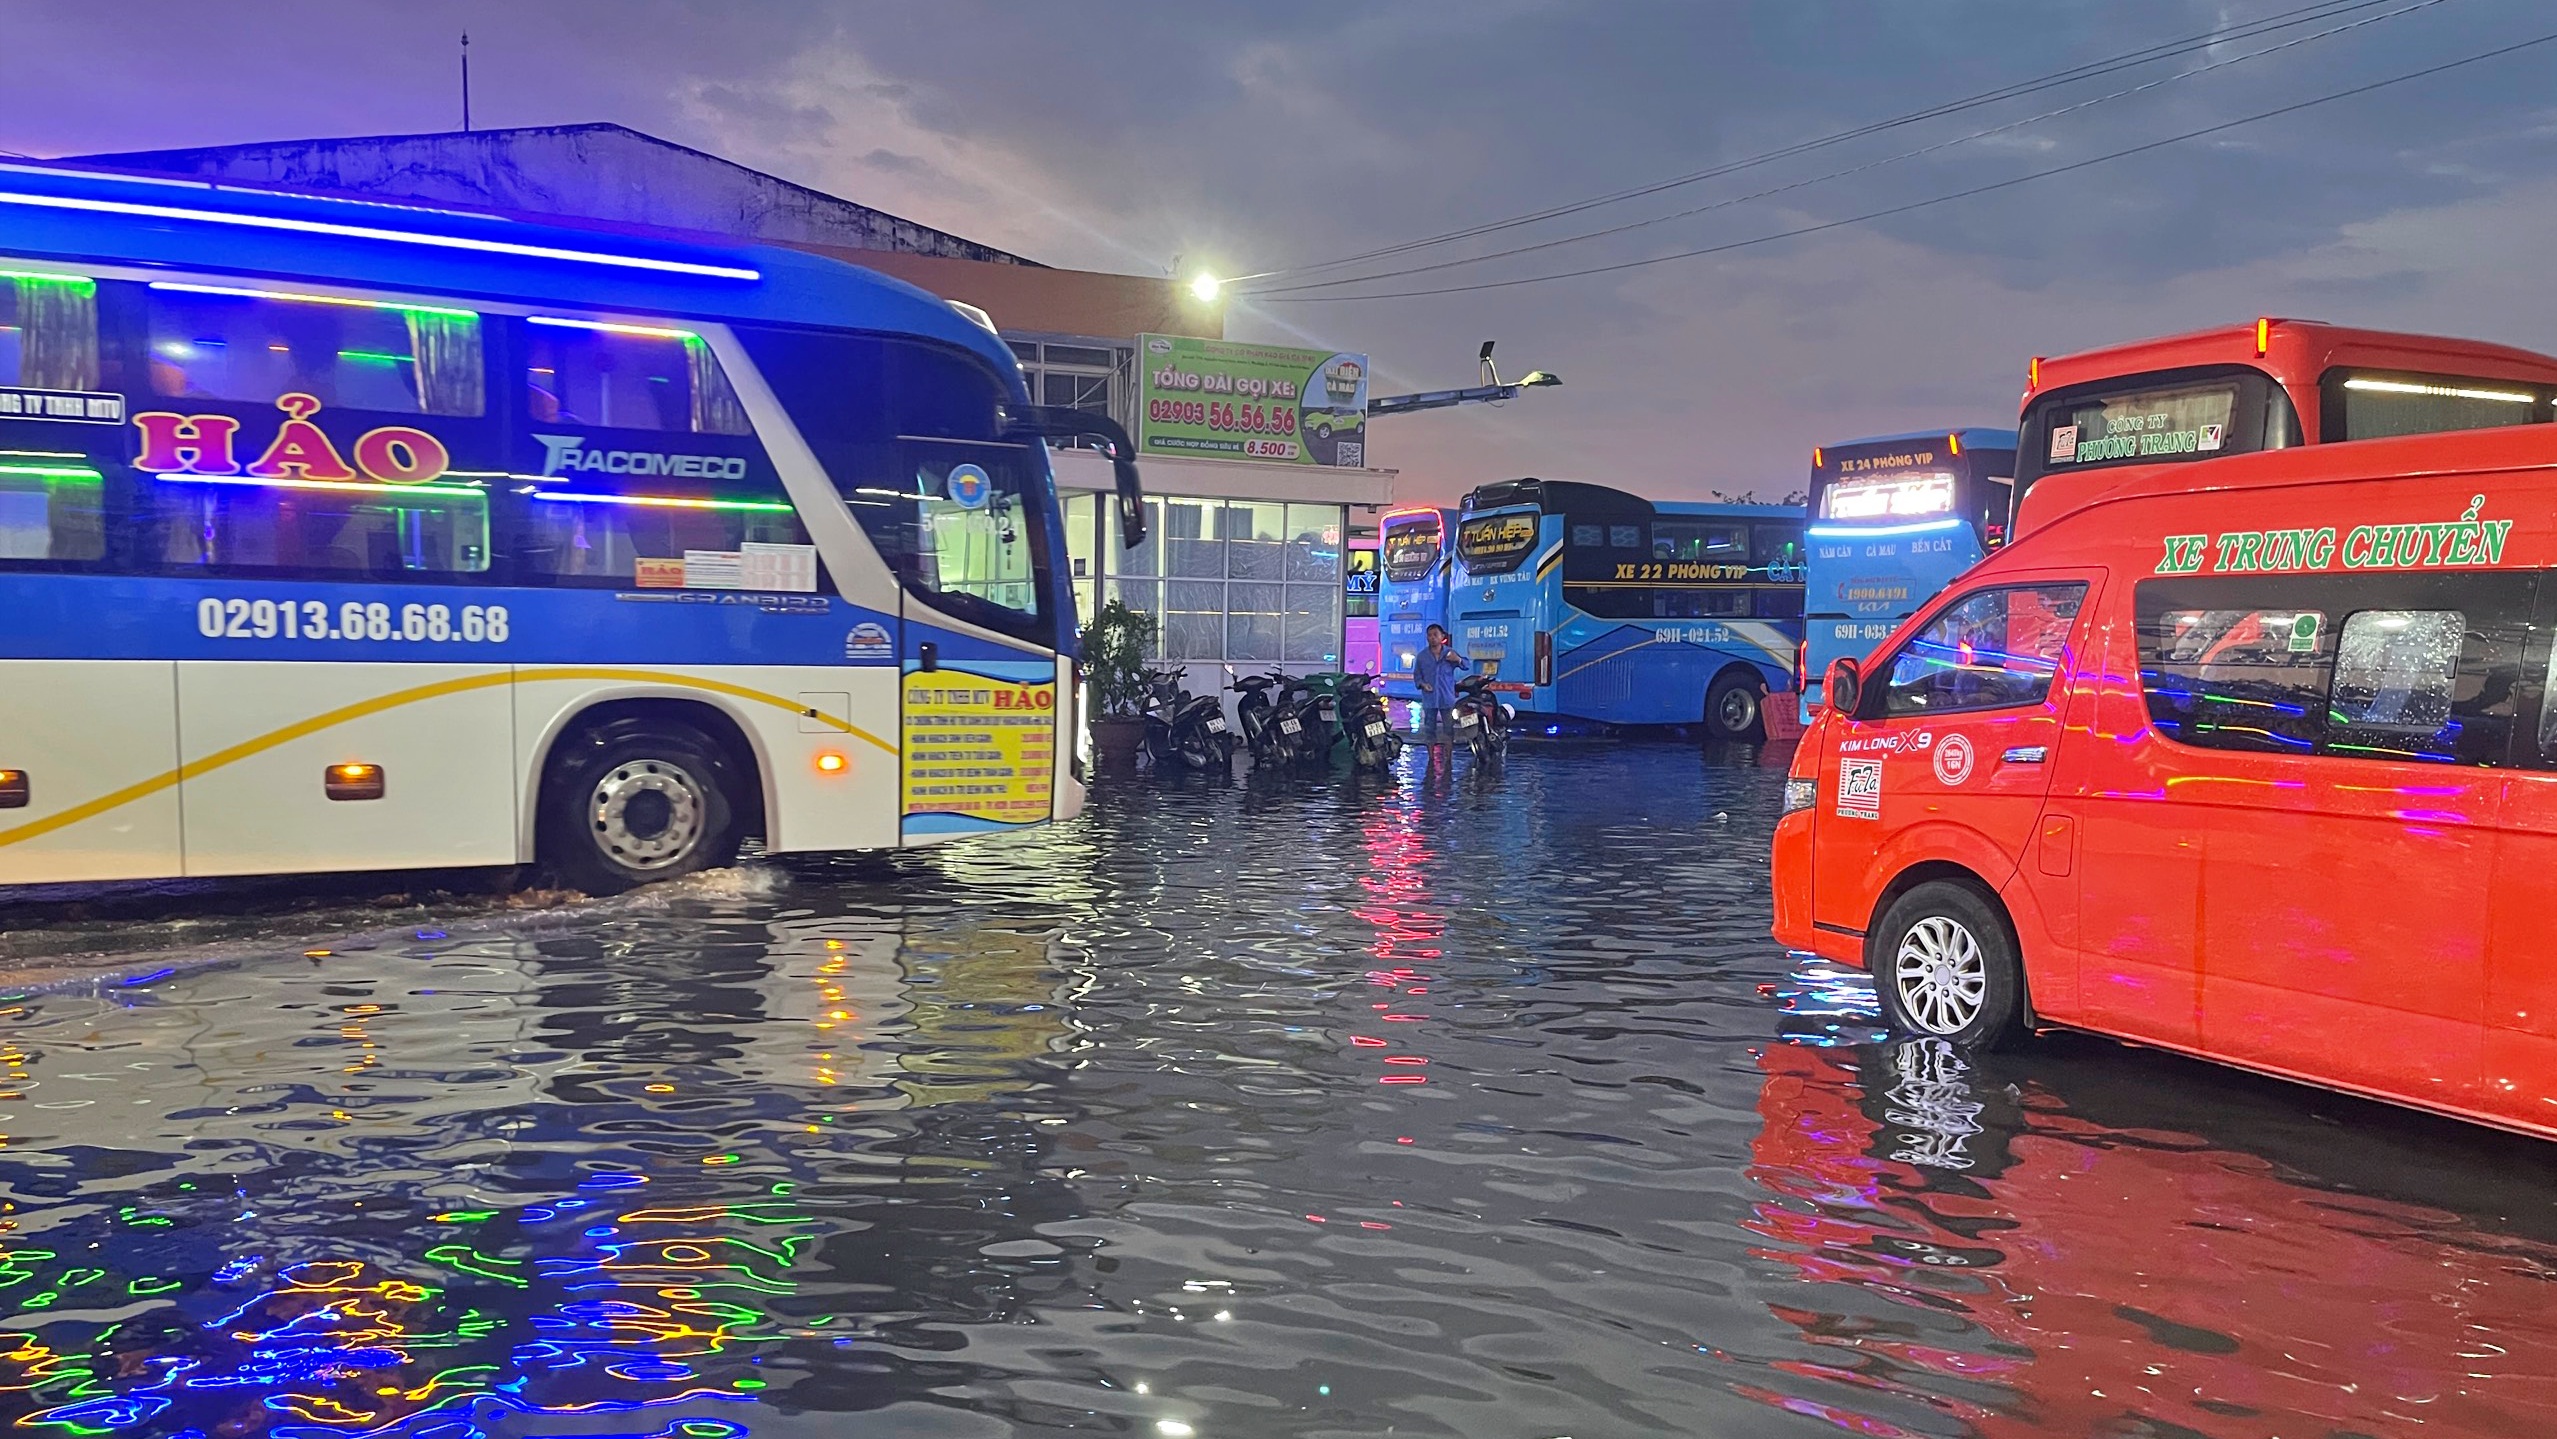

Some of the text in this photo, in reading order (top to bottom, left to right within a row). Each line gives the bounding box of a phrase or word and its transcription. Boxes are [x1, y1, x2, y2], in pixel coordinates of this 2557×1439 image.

[1152, 362, 1199, 389] TỔNG
[1203, 372, 1232, 393] ĐÀI
[1236, 378, 1267, 400] GỌI
[1271, 380, 1296, 398] XE:
[1149, 400, 1297, 435] 02903 56.56.56
[2107, 414, 2168, 434] CÔNG TY
[132, 392, 449, 485] HẢO
[1247, 441, 1286, 456] 8.500
[2076, 431, 2197, 463] PHƯƠNG TRANG
[530, 433, 746, 479] TRACOMECO
[1841, 453, 1934, 472] XE 24 PHÒNG VIP
[1471, 524, 1496, 543] TUẤN
[1866, 544, 1877, 557] CÀ
[1878, 544, 1897, 556] MAU
[1911, 538, 1930, 553] BẾN
[1933, 536, 1952, 552] CÁT
[2155, 493, 2513, 574] XE TRUNG CHUYỂN
[1615, 555, 1793, 583] XE 22 PHÒNG VIP CÀ
[198, 598, 509, 643] 02913.68.68.68
[1859, 601, 1889, 612] KIA
[1655, 627, 1730, 644] 69H-021.52
[993, 681, 1053, 710] HẢO
[1840, 739, 1861, 752] KIM
[1862, 737, 1898, 750] LONG
